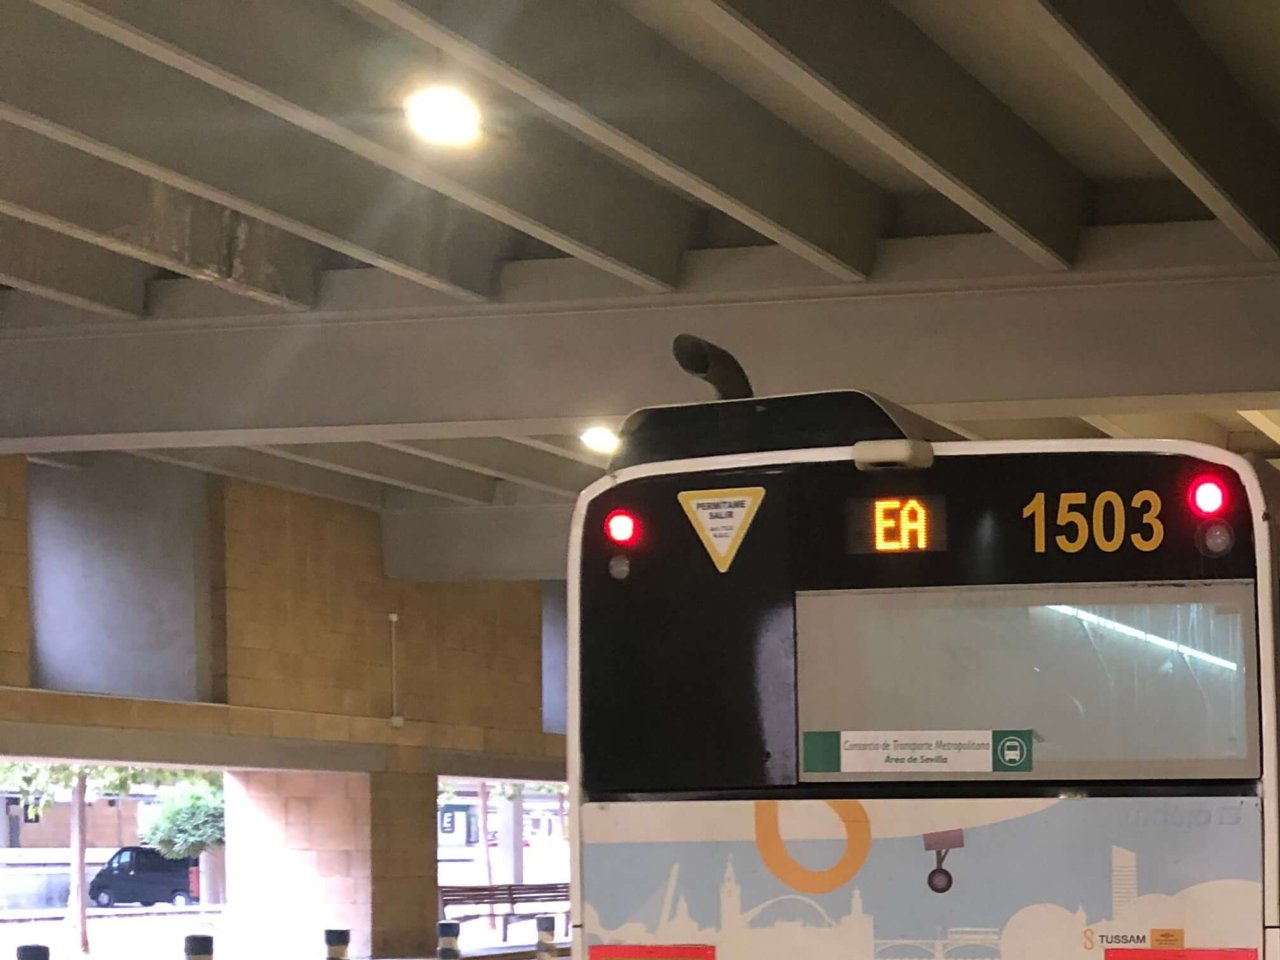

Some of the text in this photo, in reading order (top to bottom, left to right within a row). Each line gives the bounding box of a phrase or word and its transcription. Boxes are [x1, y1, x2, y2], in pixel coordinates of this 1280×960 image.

[875, 500, 927, 550] EA
[1022, 490, 1164, 552] 1503
[893, 739, 932, 752] Transporte
[935, 739, 990, 753] Metropolitano
[907, 755, 918, 764] de
[920, 755, 948, 764] Sevilla
[1099, 934, 1146, 945] TUSSAM
